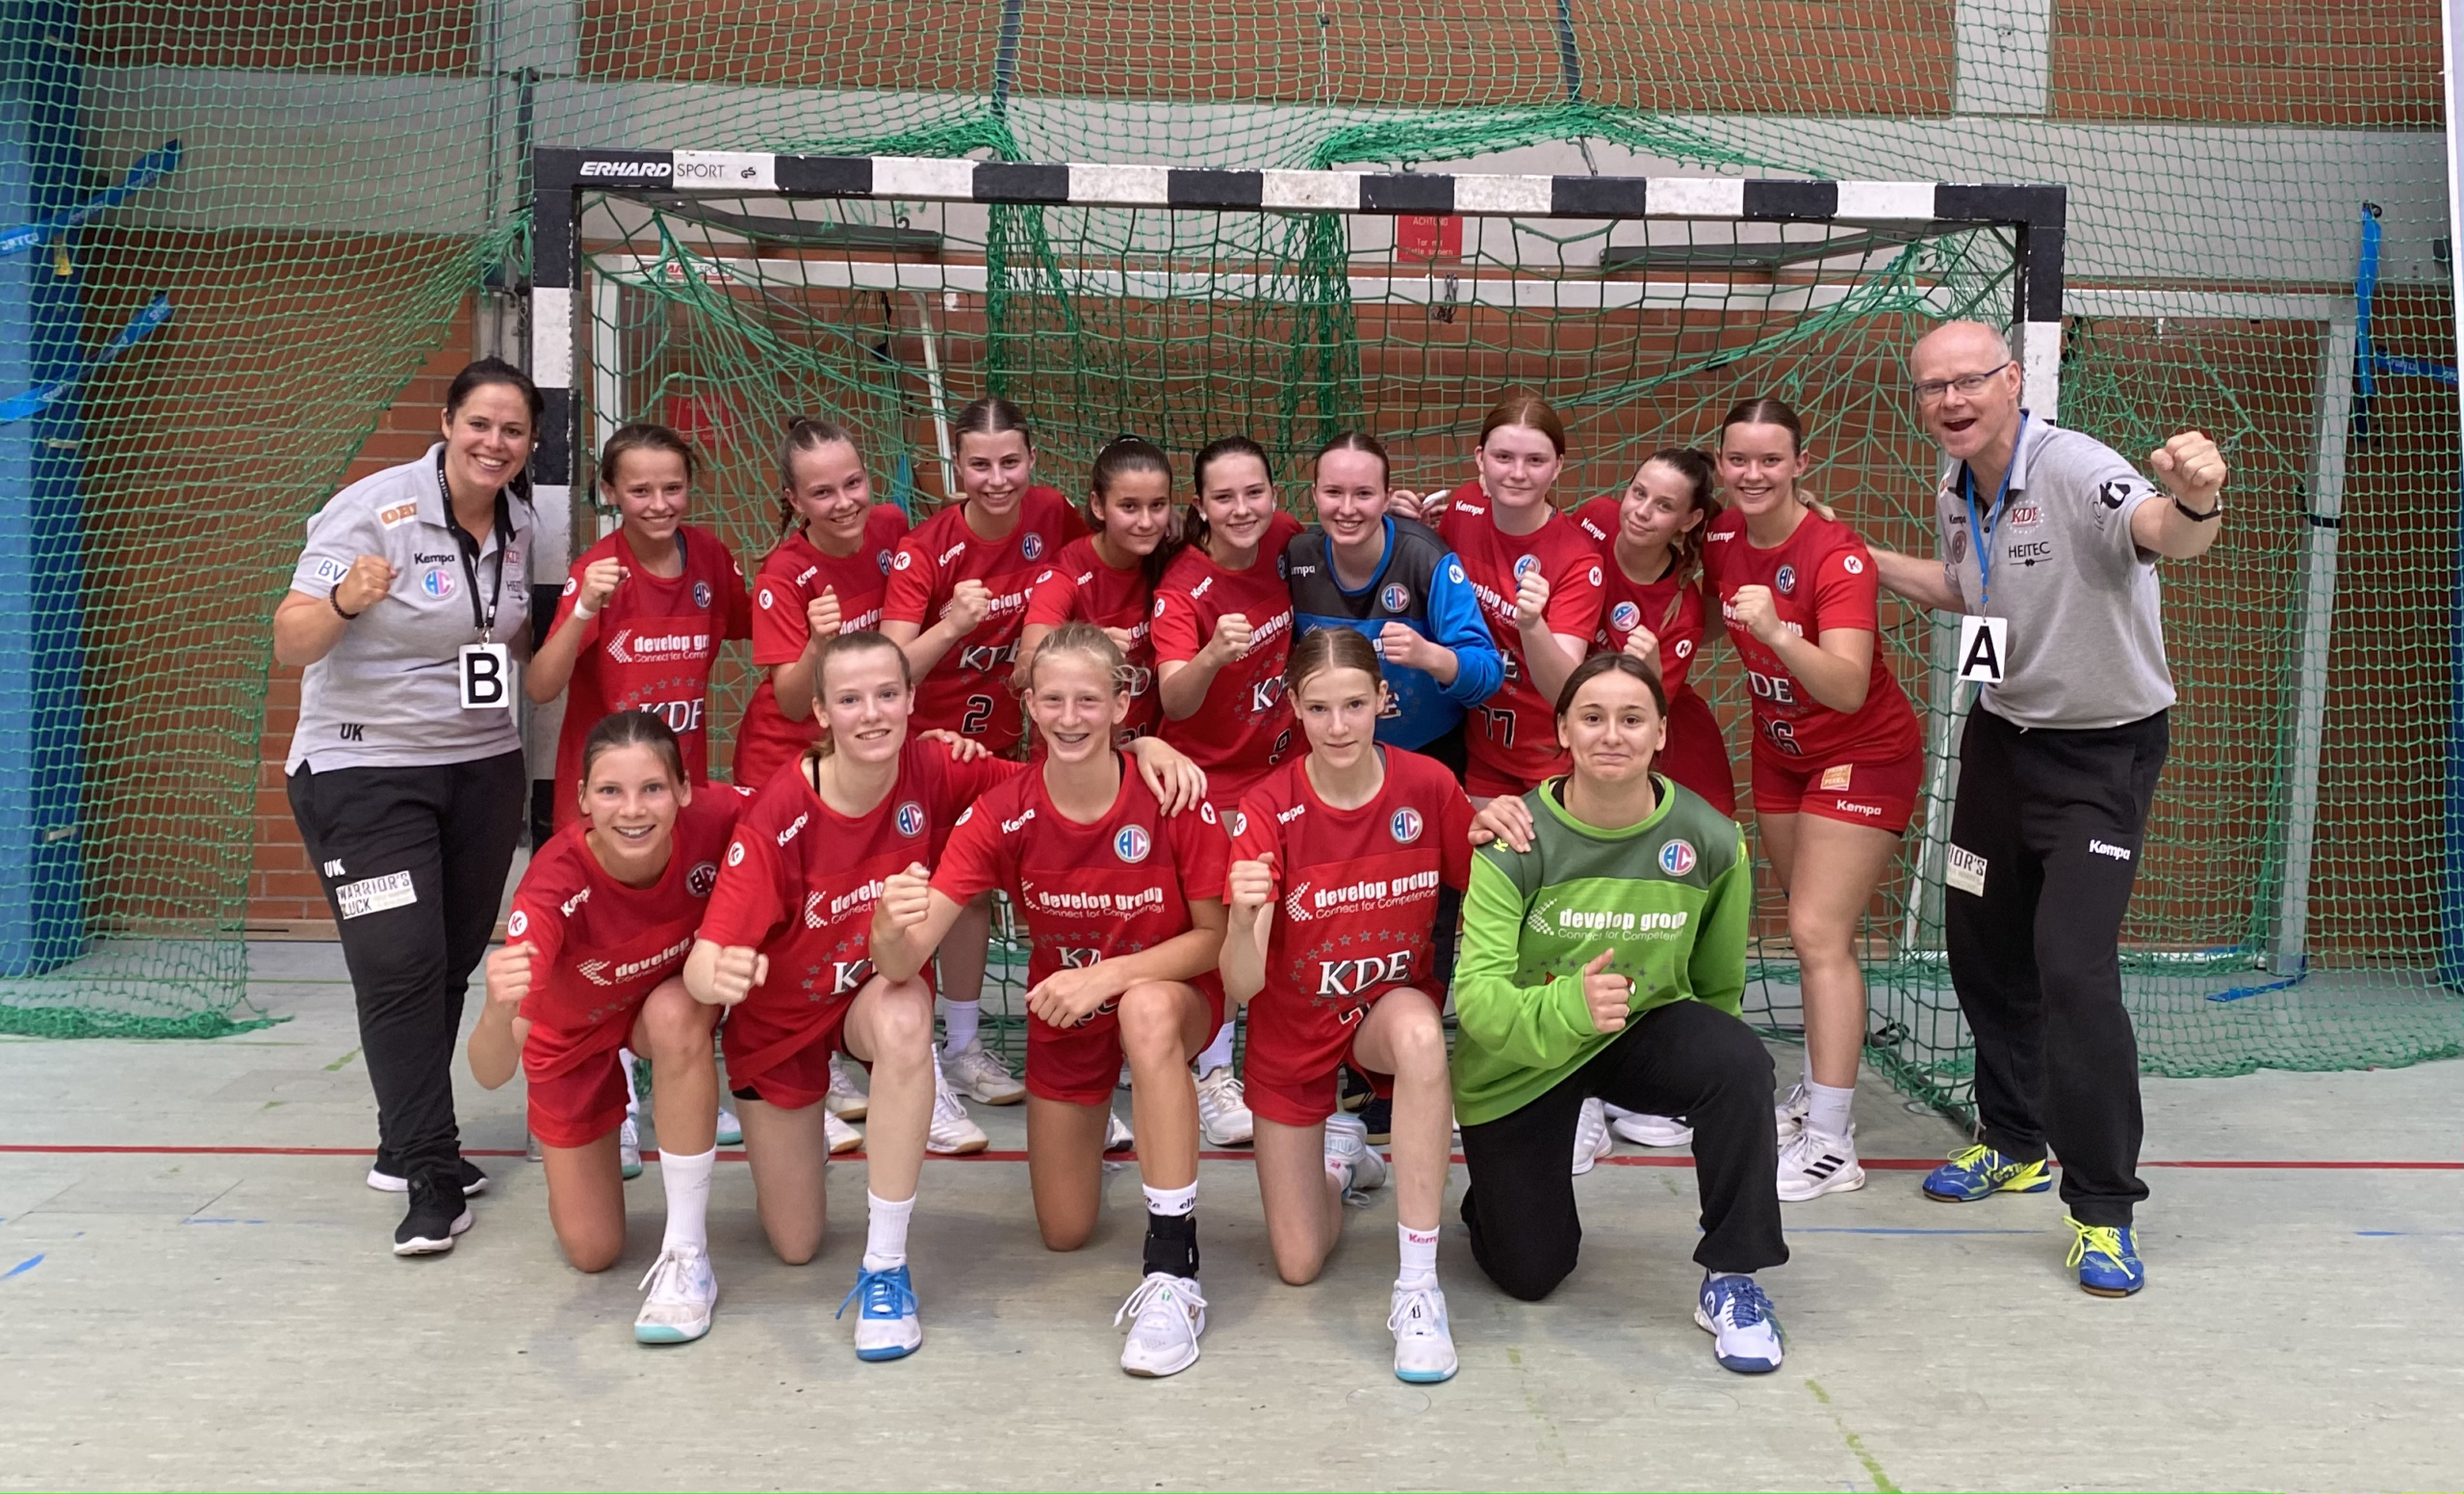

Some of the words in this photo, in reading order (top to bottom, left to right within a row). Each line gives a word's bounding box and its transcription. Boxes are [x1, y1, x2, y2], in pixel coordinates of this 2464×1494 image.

[579, 161, 672, 178] ERHARD
[677, 164, 726, 178] SPORT
[1454, 500, 1485, 516] Kempa
[1580, 517, 1607, 541] Kempa
[414, 553, 455, 565] Kempa
[2008, 541, 2051, 558] HEITEC
[634, 634, 689, 653] develop
[1961, 625, 2001, 679] A
[466, 653, 503, 705] B
[961, 694, 993, 734] 2
[340, 723, 365, 741] UK
[1836, 799, 1883, 817] Kempa
[1118, 830, 1145, 860] HC
[2089, 838, 2131, 862] Kempa
[323, 858, 346, 878] UK
[1663, 844, 1692, 871] HC
[338, 872, 411, 901] WARRIOR'S
[1314, 881, 1387, 909] develop
[1392, 870, 1439, 898] group
[1039, 891, 1112, 909] develop
[1115, 887, 1164, 911] group
[1315, 903, 1359, 919] Connect
[1361, 899, 1375, 913] for
[831, 901, 873, 925] Connect
[1041, 906, 1084, 918] Connect
[1086, 910, 1100, 918] for
[1559, 909, 1635, 930] develop
[1557, 928, 1603, 941] Connect
[1604, 929, 1620, 940] for
[614, 937, 690, 977] develop
[1315, 950, 1413, 999] KDE
